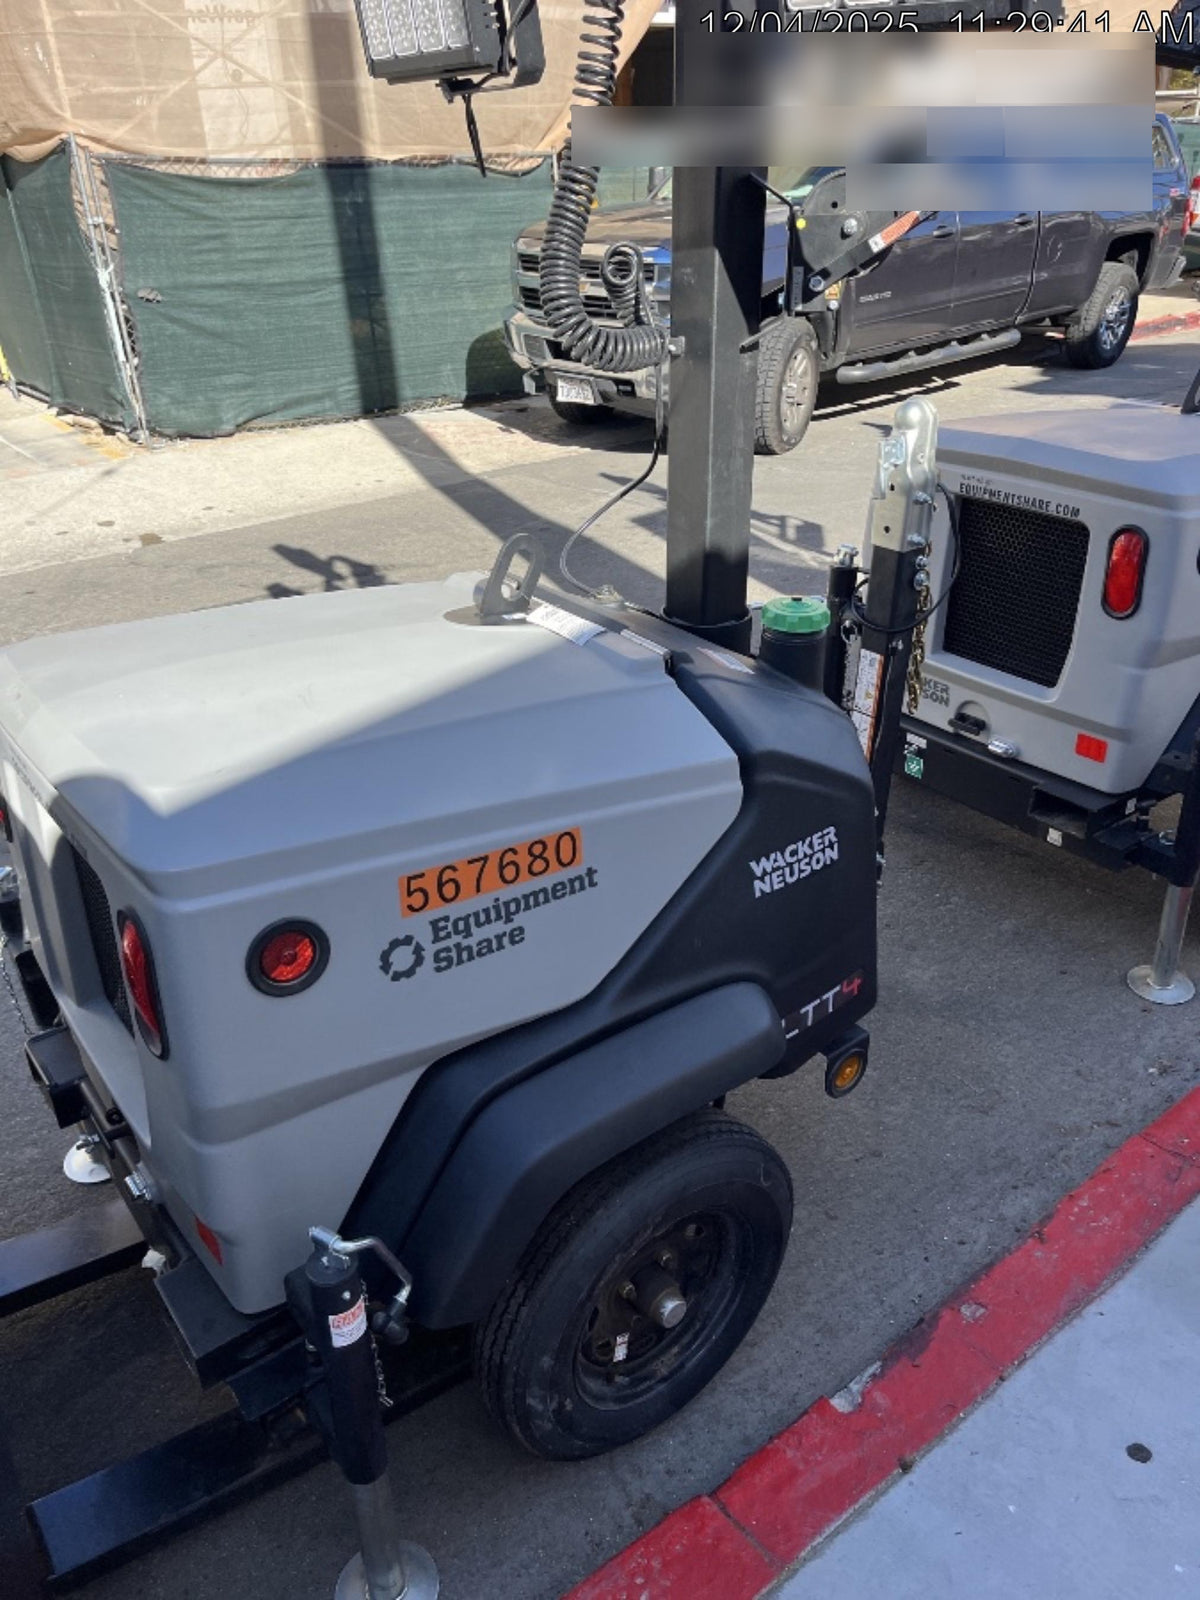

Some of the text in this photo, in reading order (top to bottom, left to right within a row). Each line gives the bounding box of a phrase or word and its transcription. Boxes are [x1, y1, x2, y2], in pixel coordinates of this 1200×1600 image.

[959, 482, 1081, 518] EQUIPMENTSHARE.COM
[922, 690, 950, 708] SON
[923, 677, 950, 696] KER
[405, 831, 578, 913] 567680
[748, 825, 839, 877] WACKER
[752, 841, 839, 899] NEUSON
[428, 866, 599, 945] Equipment
[432, 925, 526, 973] Share
